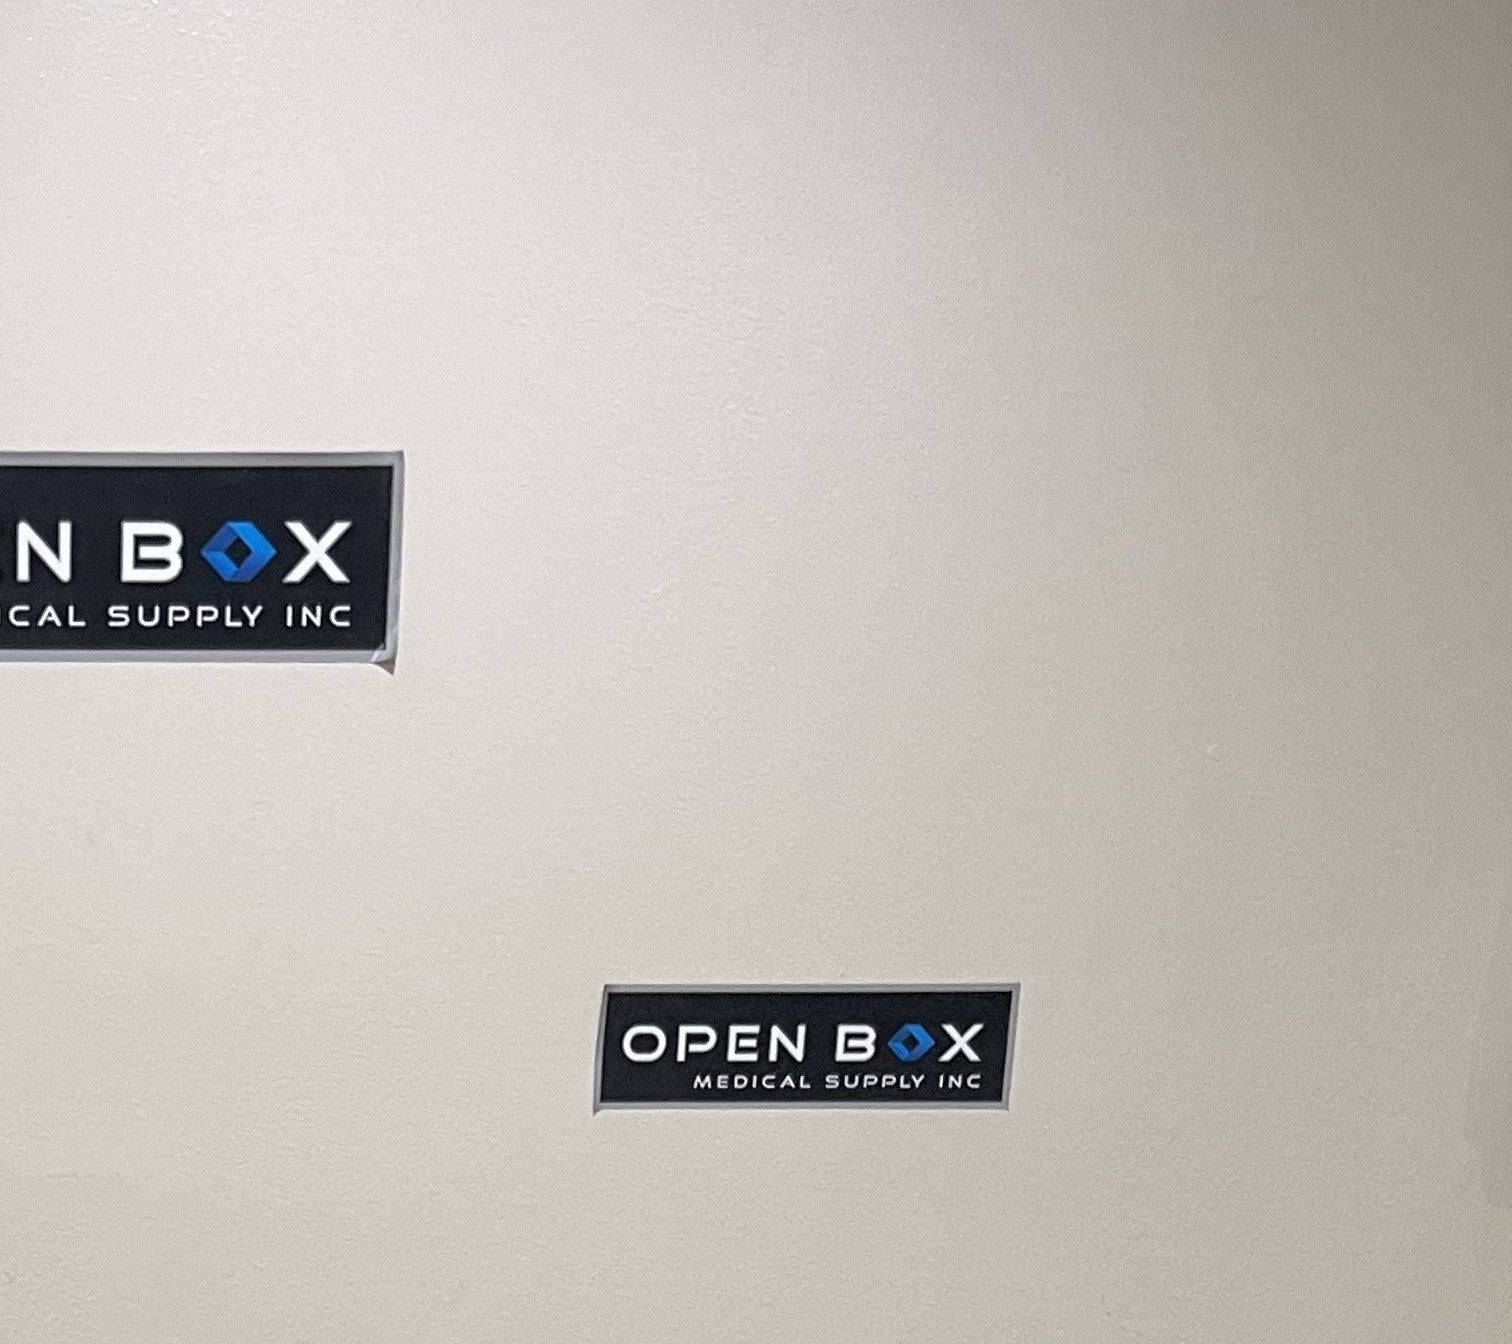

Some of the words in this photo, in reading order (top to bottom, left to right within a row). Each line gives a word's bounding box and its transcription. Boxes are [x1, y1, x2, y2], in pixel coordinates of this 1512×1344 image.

[120, 519, 353, 583] BOX
[107, 603, 263, 628] SUPPLY
[285, 603, 353, 628] INC
[621, 1022, 807, 1063] OPEN
[835, 1022, 985, 1063] BOX
[693, 1073, 812, 1090] MEDICAL
[825, 1073, 925, 1090] SUPPLY
[938, 1073, 982, 1090] INC
